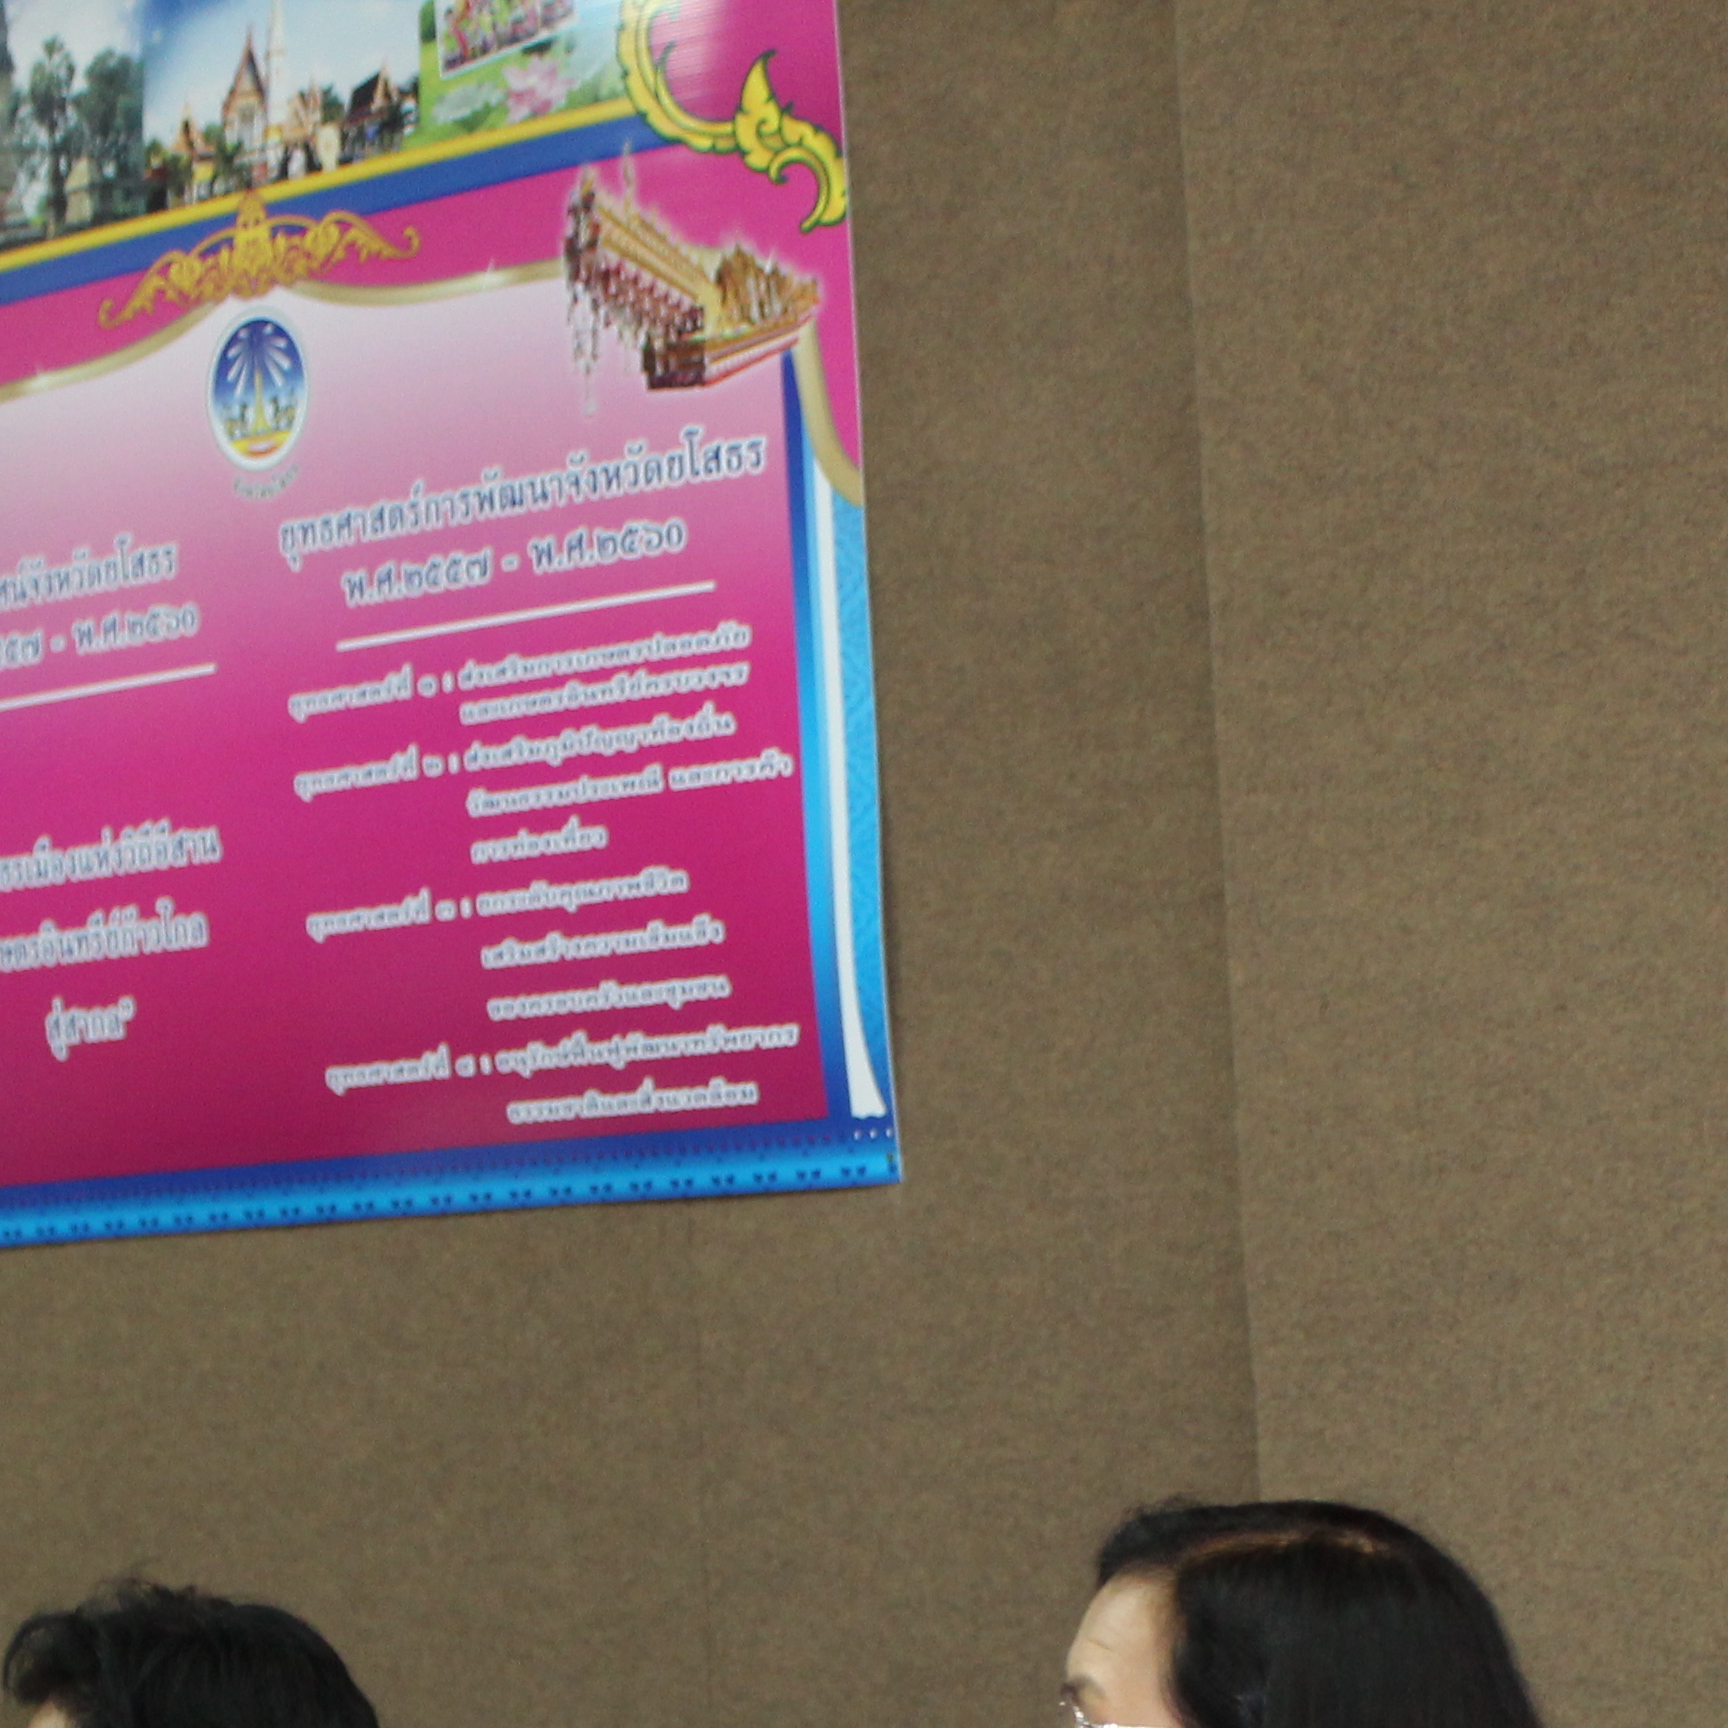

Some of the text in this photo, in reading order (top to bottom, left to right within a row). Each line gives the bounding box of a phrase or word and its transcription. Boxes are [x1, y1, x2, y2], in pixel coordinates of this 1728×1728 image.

[279, 427, 767, 571] ยุทธศาสตร์การพัฒนาจังหวัดยโสธร
[341, 550, 490, 608] พ.ศ.๒๕๕๗
[530, 518, 687, 574] พ.ศ.๒๕๖๐
